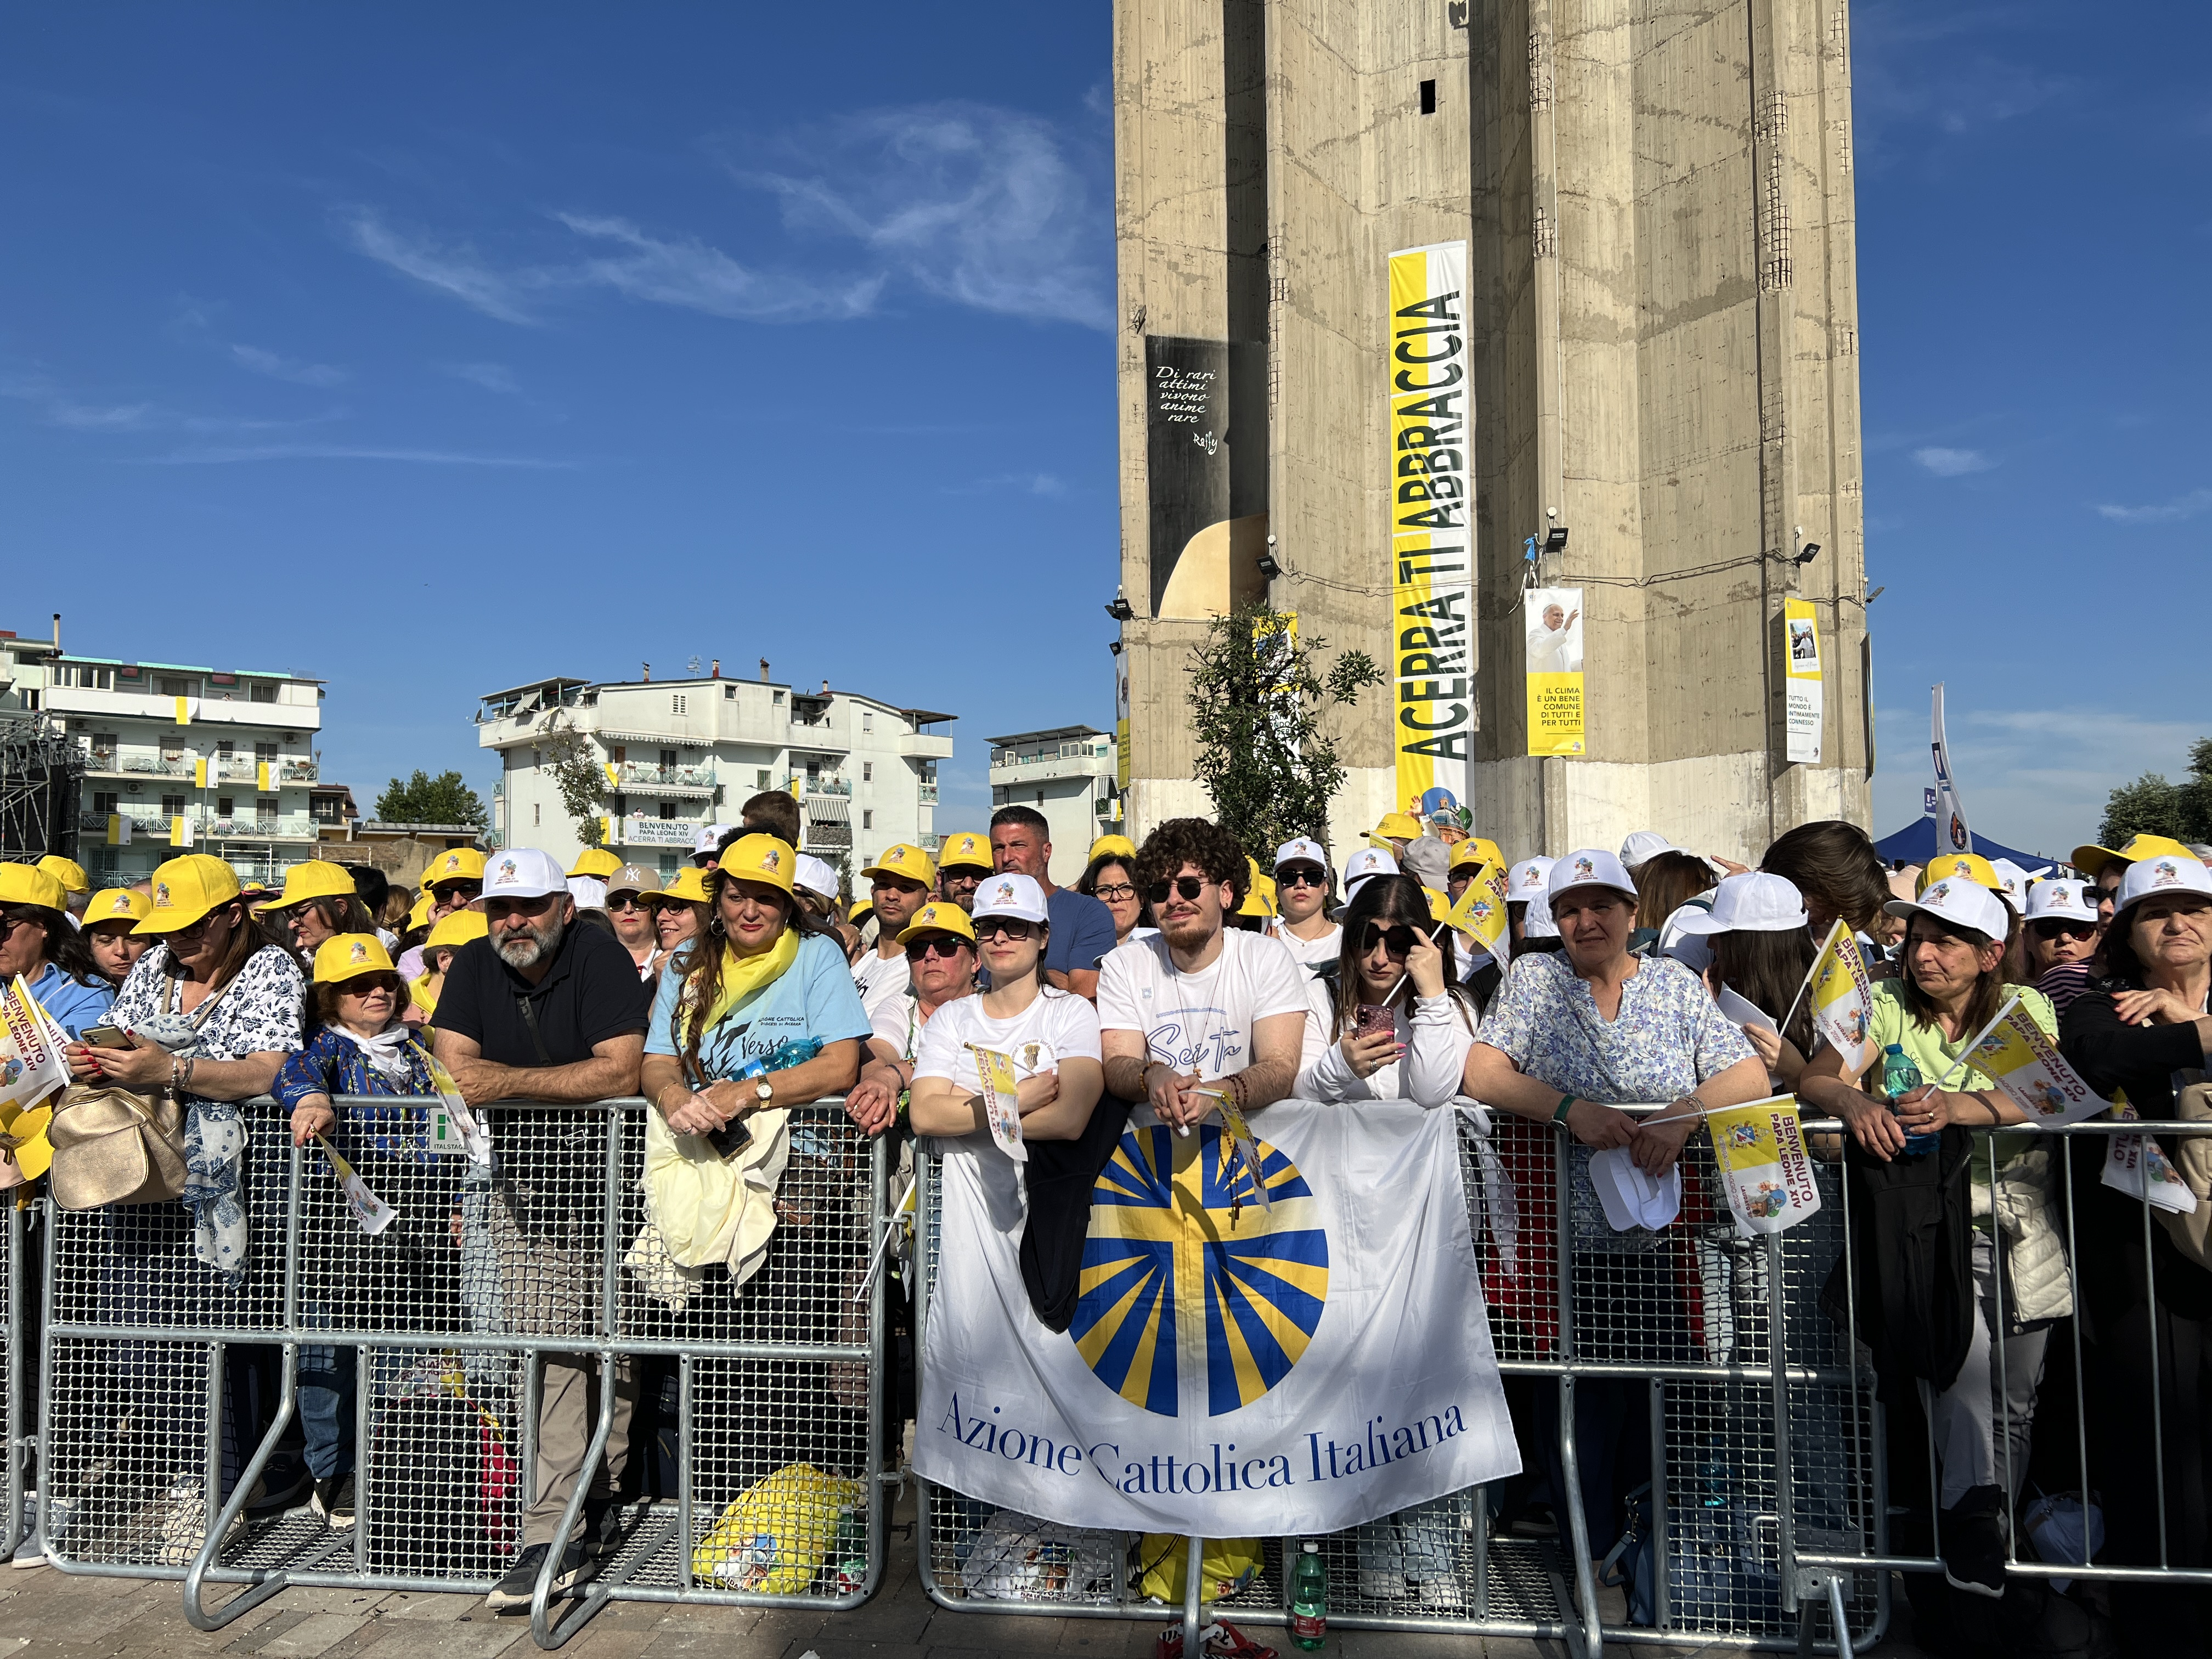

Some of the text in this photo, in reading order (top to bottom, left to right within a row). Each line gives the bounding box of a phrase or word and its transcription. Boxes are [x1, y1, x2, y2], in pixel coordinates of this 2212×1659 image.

[1156, 366, 1217, 380] Di rari
[1159, 379, 1208, 390] attimi
[1160, 390, 1211, 401] vivono
[1160, 401, 1207, 413] anime
[1395, 290, 1469, 761] ACERRA TI ABBRACCIA
[639, 822, 688, 830] BENVENUTO
[1463, 923, 1483, 938] ACERRA
[1489, 941, 1504, 962] MAGGIO
[1833, 941, 1852, 969] PAPA
[1851, 970, 1866, 1008] LEONE
[1841, 938, 1872, 1017] BENVENUTO
[7, 990, 46, 1063] BENVENUTO
[8, 1020, 29, 1054] LEONE
[24, 1055, 37, 1071] XIV
[1834, 1019, 1850, 1042] LAUDATO
[2003, 1014, 2081, 1102] PAPA LEONE XIV
[2016, 1013, 2086, 1096] BENVENUTO
[1770, 1113, 1802, 1209] PAPA LEONE XIV
[1782, 1116, 1813, 1201] BENVENUTO
[1725, 1169, 1736, 1193] MAGGIO
[1733, 1194, 1741, 1209] 2026
[1740, 1186, 1751, 1210] LAUDATO
[937, 1391, 1469, 1494] Azione Cattolica Italiana
